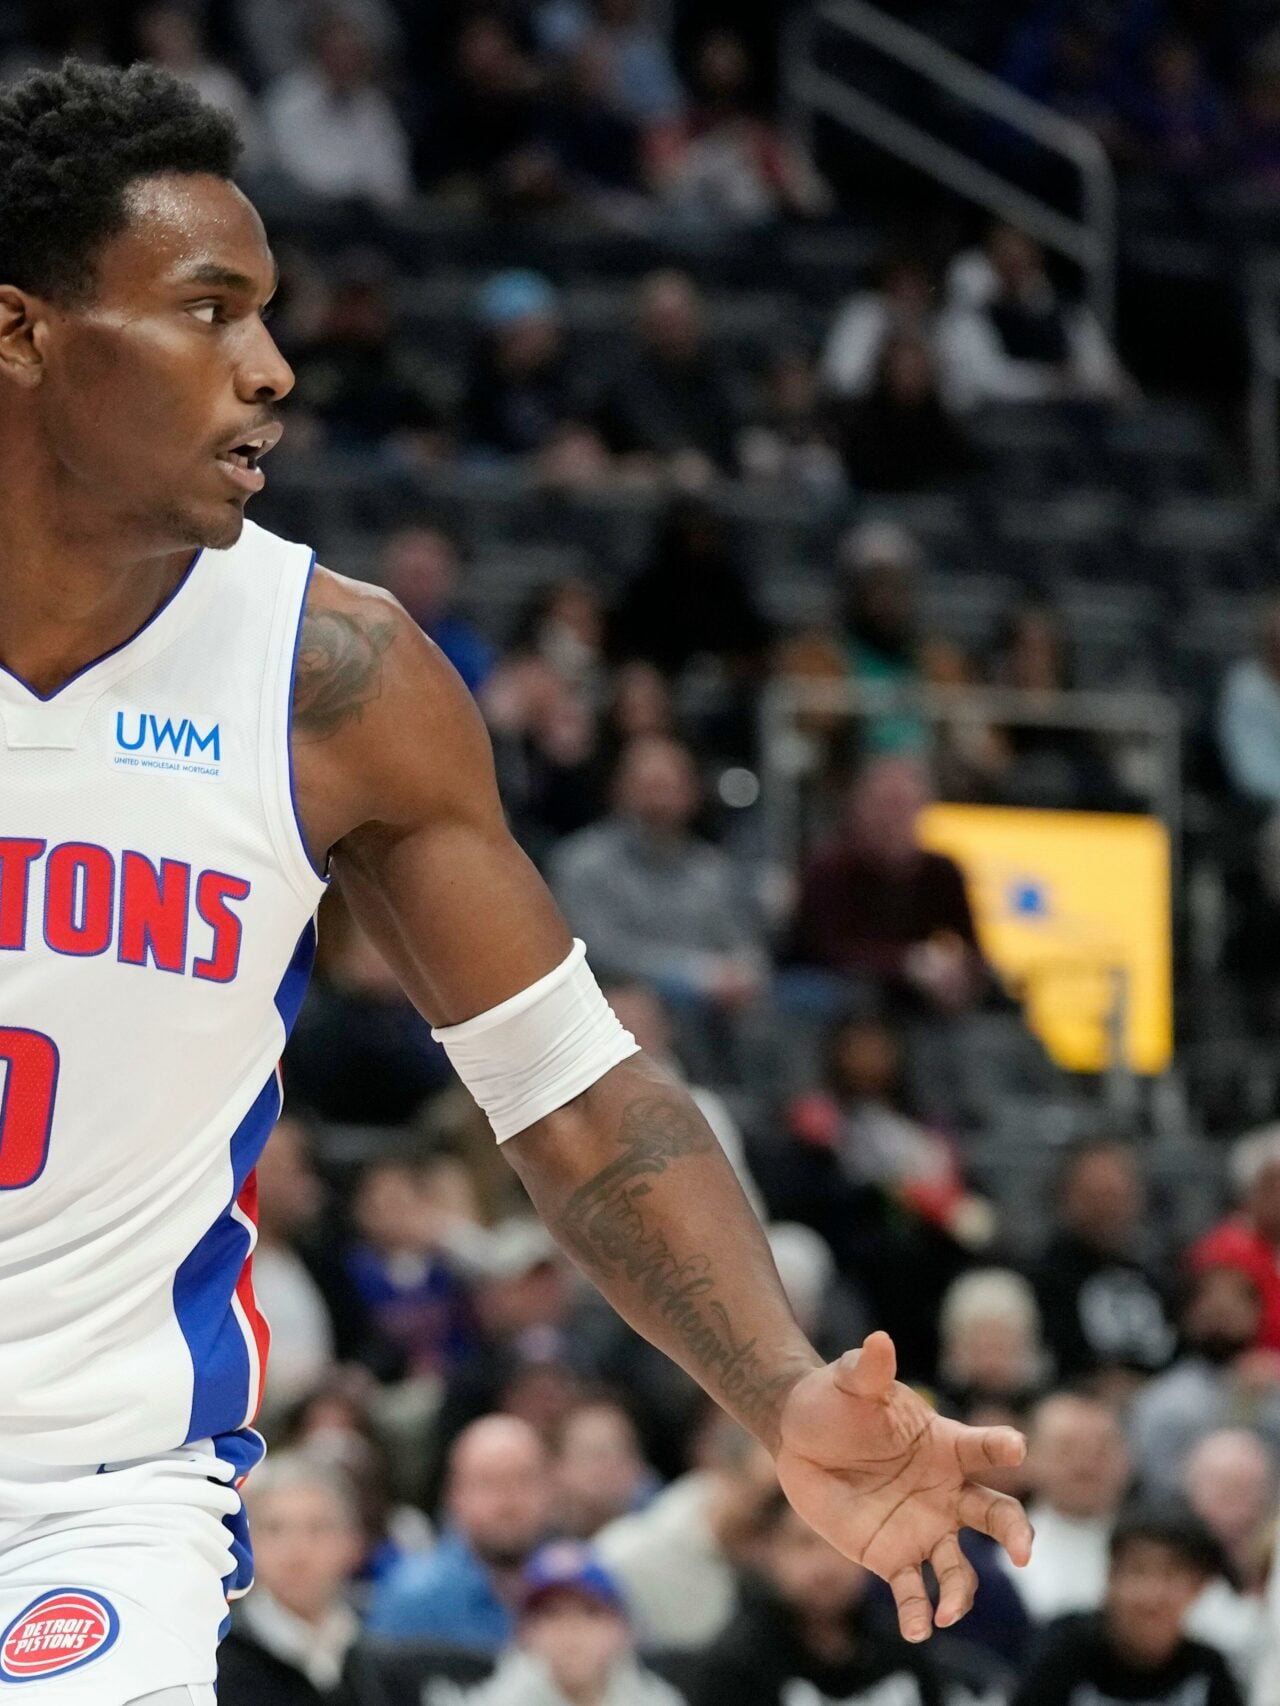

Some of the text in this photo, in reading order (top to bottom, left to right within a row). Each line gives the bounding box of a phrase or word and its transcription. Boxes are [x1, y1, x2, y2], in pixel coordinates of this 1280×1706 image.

[116, 711, 220, 761] UWM
[114, 756, 220, 776] UNITED WHOLESALE MORTGAGE
[22, 1618, 96, 1639] DETROIT
[13, 1633, 89, 1656] PISTONS
